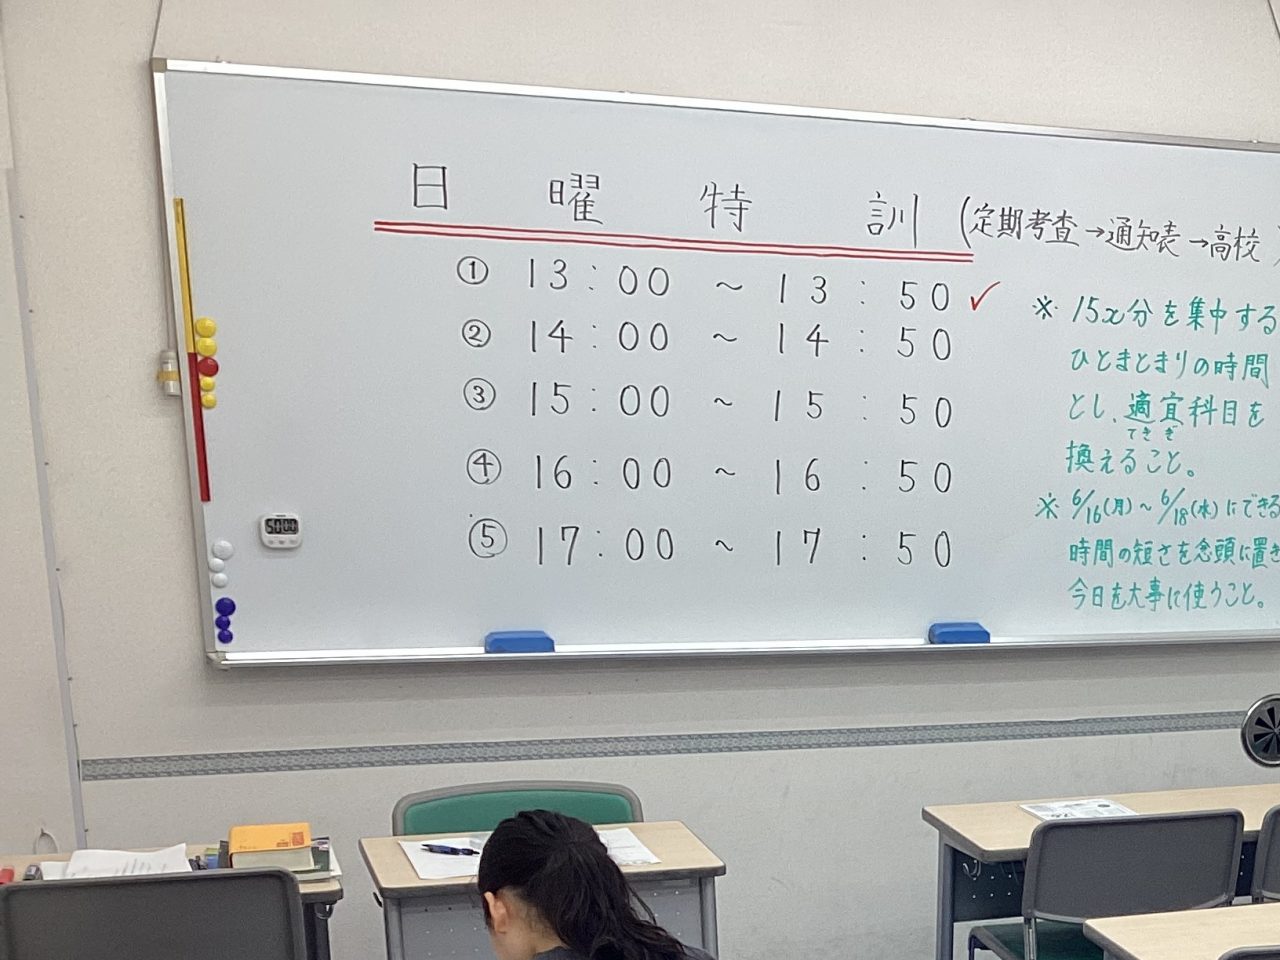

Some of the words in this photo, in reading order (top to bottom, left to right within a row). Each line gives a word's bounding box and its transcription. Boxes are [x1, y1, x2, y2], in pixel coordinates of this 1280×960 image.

[1070, 348, 1270, 389] ひとまとまりの時間
[1066, 439, 1196, 478] 換えること。
[1066, 576, 1266, 611] 今日を大事に使うこと。
